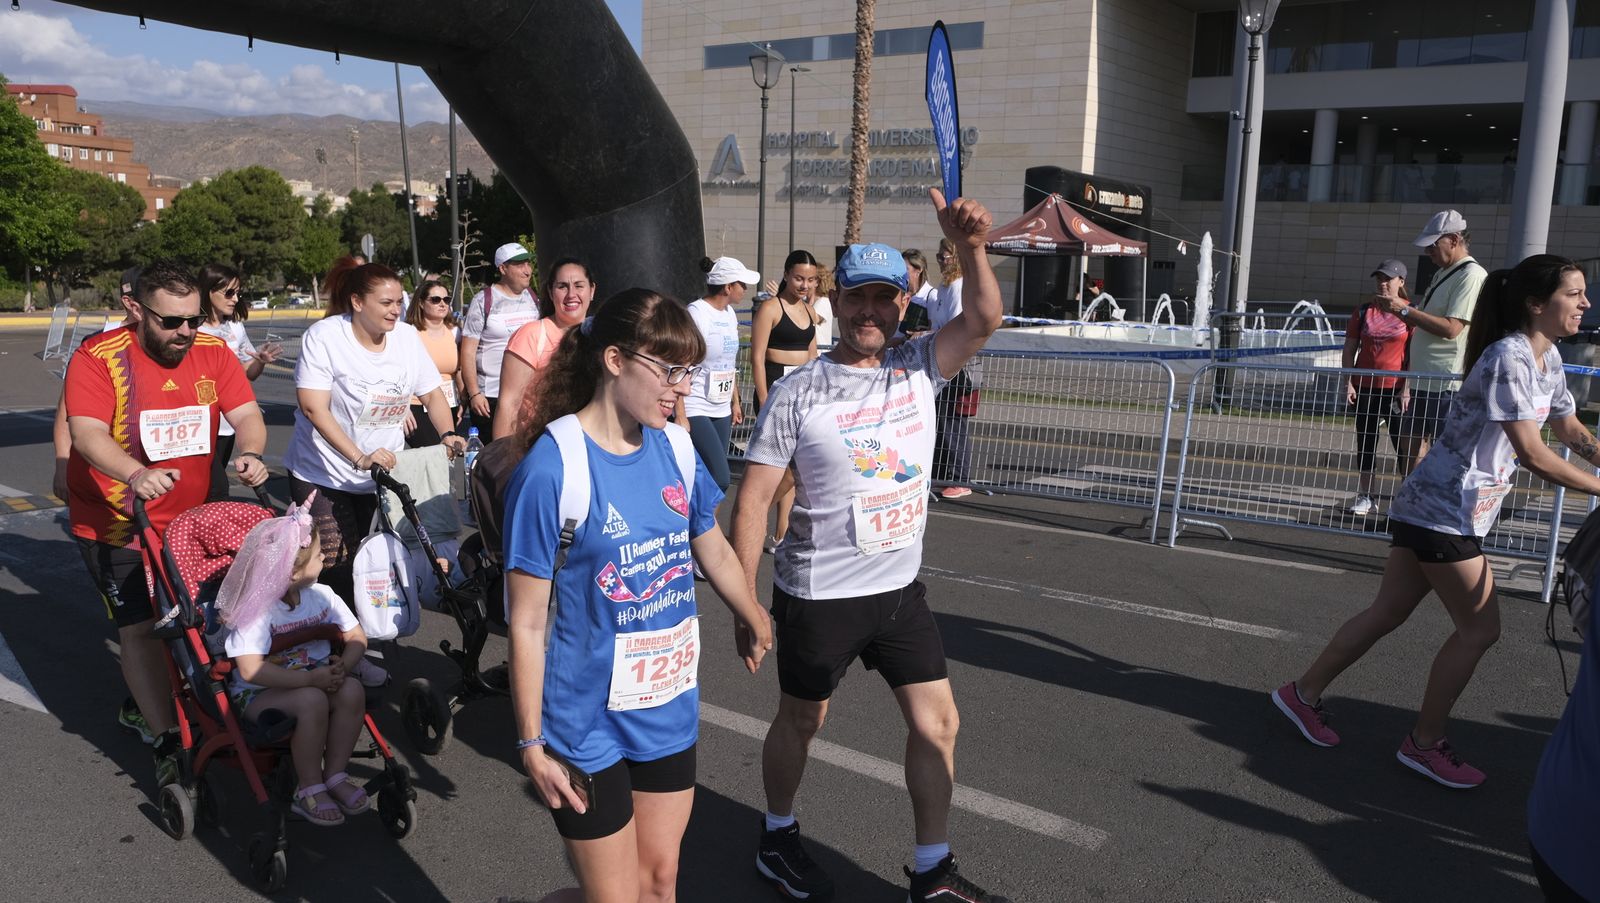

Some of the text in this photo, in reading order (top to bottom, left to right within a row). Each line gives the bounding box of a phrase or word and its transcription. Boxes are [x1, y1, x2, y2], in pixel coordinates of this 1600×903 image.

[767, 131, 839, 149] HOSPITAL
[370, 404, 407, 417] 1188
[150, 422, 202, 443] 1187
[870, 496, 924, 533] 1234
[602, 520, 628, 535] ALTEA
[619, 543, 633, 566] II
[632, 536, 666, 558] Runner
[646, 548, 666, 572] azul
[667, 551, 678, 563] por
[634, 634, 672, 647] CARRERA
[631, 641, 695, 683] 1235
